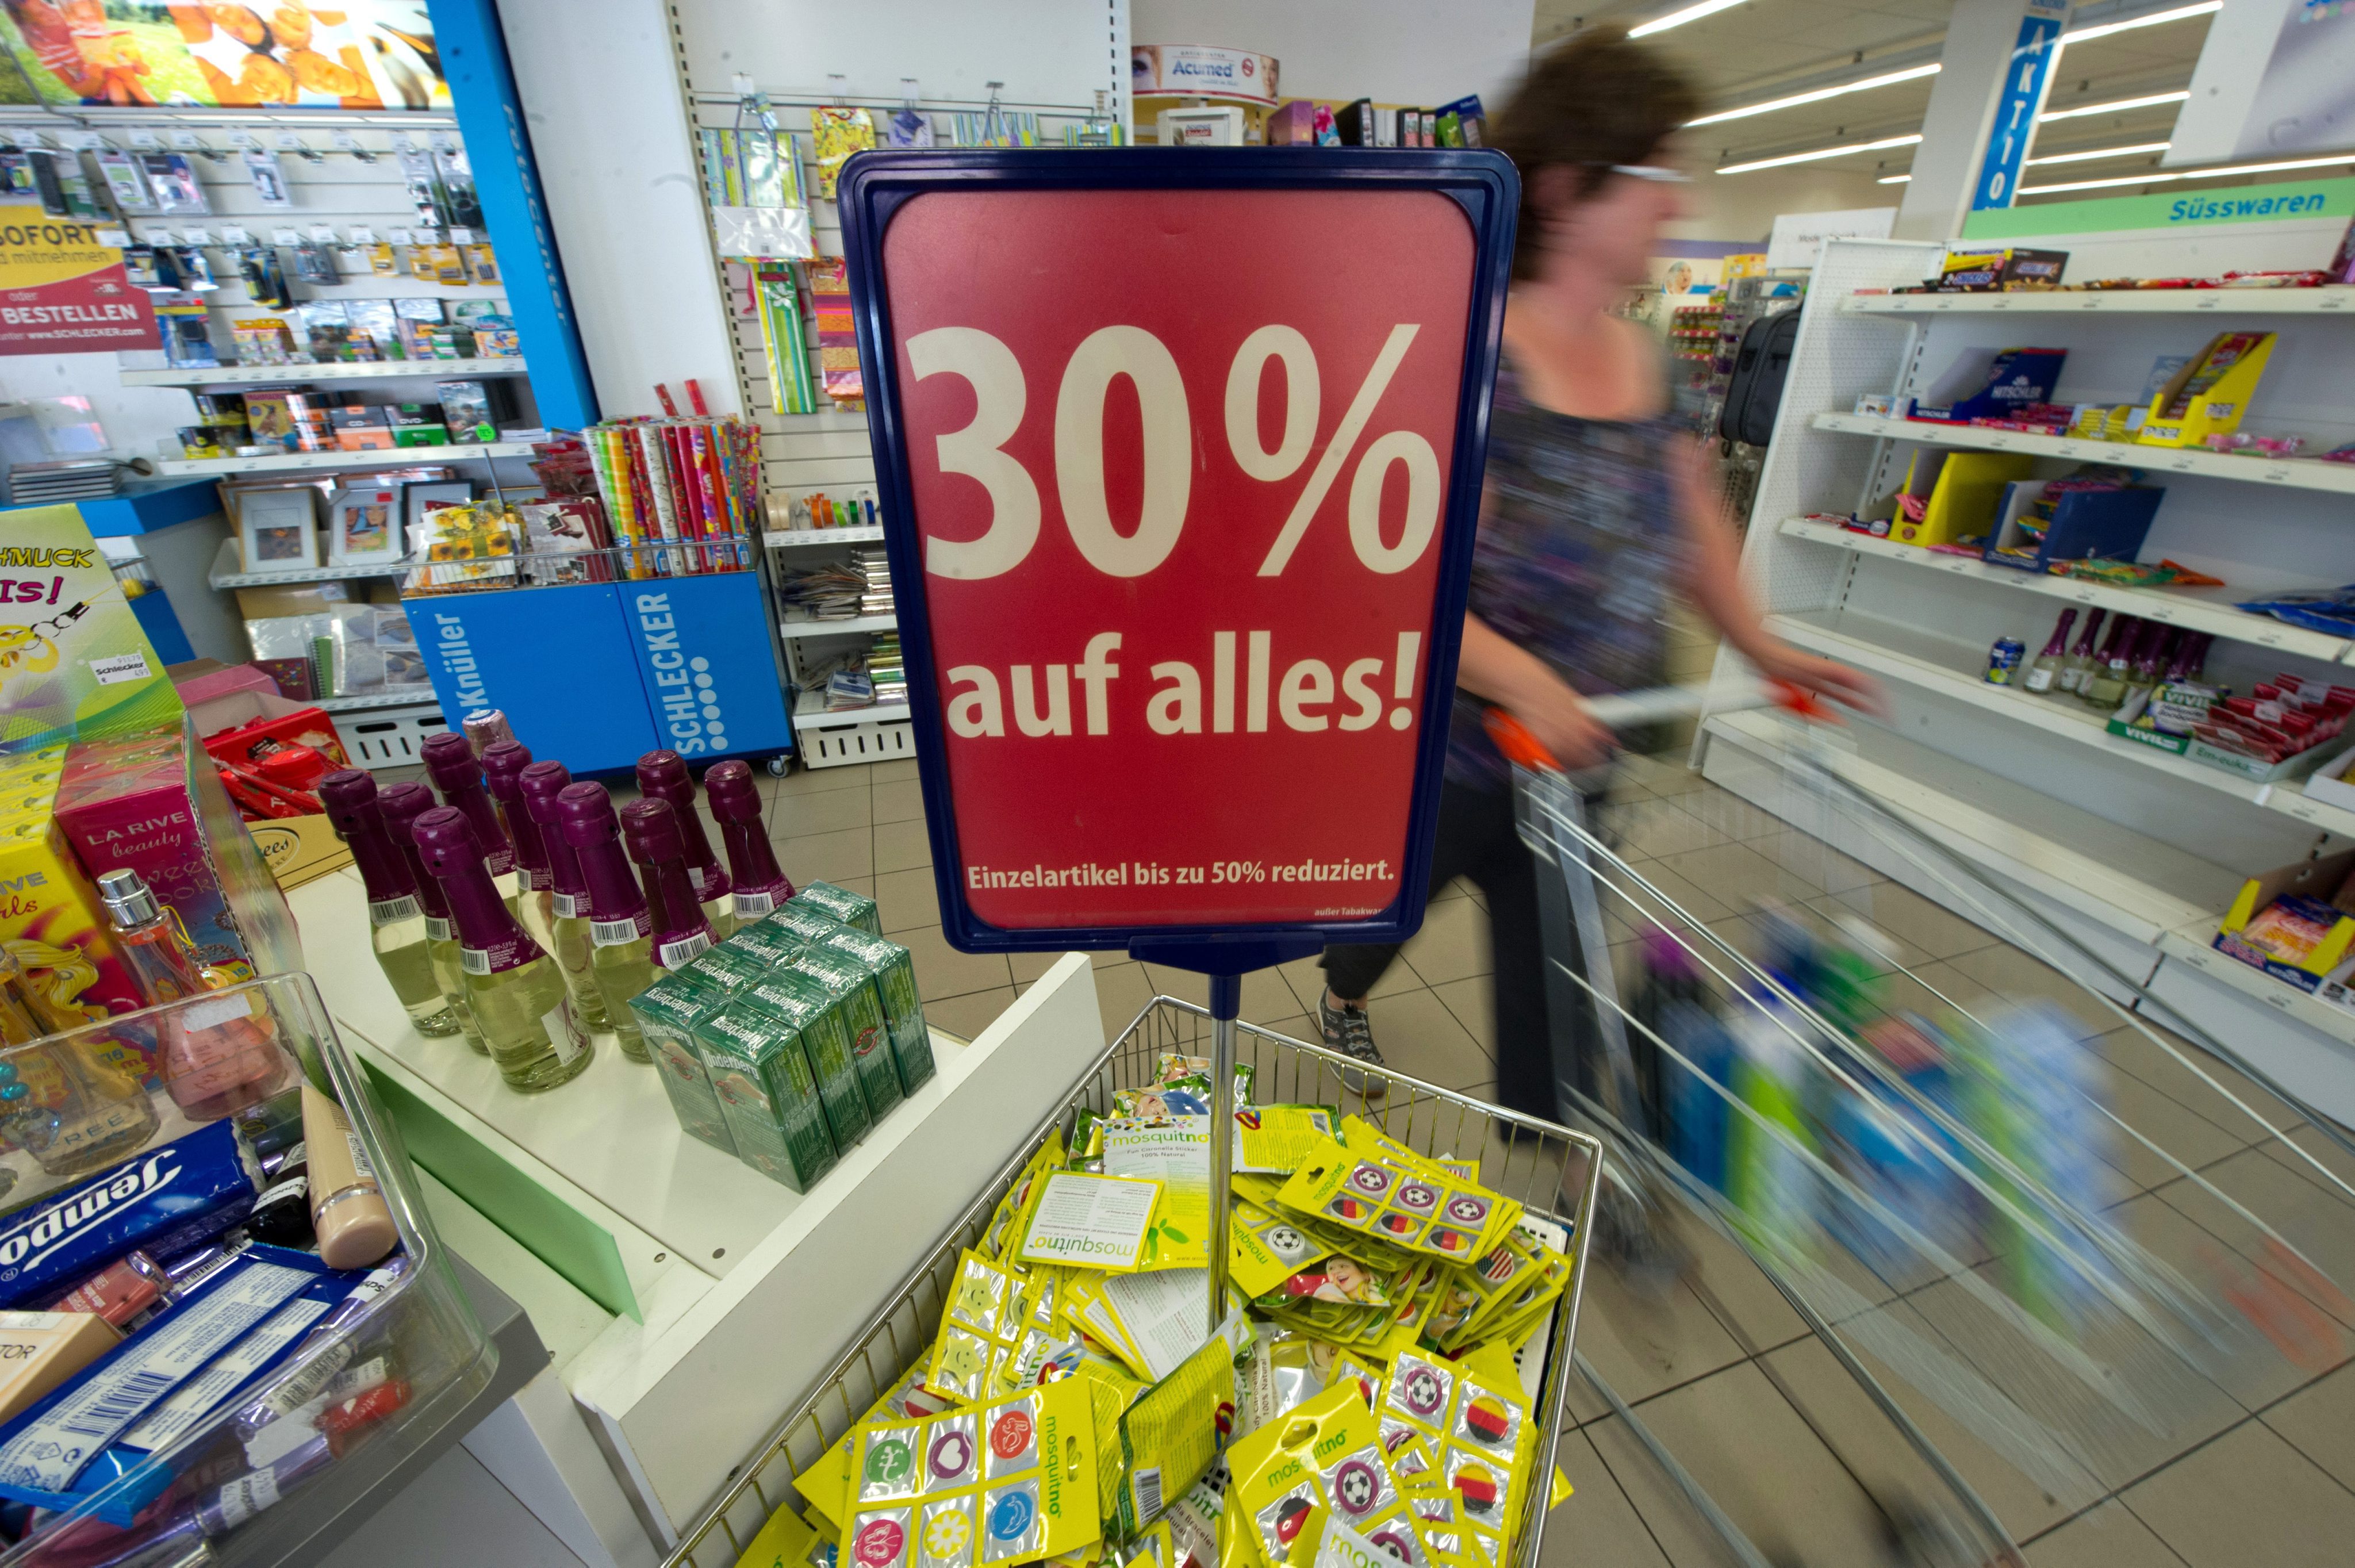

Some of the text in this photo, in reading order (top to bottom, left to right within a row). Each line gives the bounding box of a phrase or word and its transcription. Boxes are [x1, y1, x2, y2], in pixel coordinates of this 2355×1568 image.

[1172, 60, 1233, 78] Acumed
[1984, 25, 2045, 211] AKTIO
[2169, 193, 2326, 221] Süsswaren
[8, 292, 38, 302] oder
[1, 304, 139, 325] BESTELLEN
[28, 328, 145, 340] www.SCHLECKER.com
[906, 324, 1441, 581] 30%
[636, 593, 706, 754] SCHLECKER
[946, 630, 1421, 739] auf alles!
[87, 811, 189, 846] LA RIVE
[112, 831, 182, 858] beauty
[968, 858, 1395, 890] Einzelartikel bis zu 50% reduziert.
[1315, 907, 1340, 916] außer
[645, 986, 703, 1018] Underberg
[636, 1018, 693, 1047] Underberg
[700, 1048, 760, 1080] Underberg
[1113, 1130, 1210, 1147] mosquitno
[0, 1149, 177, 1265] Tempo
[1035, 1236, 1136, 1256] mosquitno
[1260, 1358, 1268, 1391] Natural
[1044, 1416, 1064, 1516] mosquitno
[1184, 1514, 1215, 1550] Bracelet
